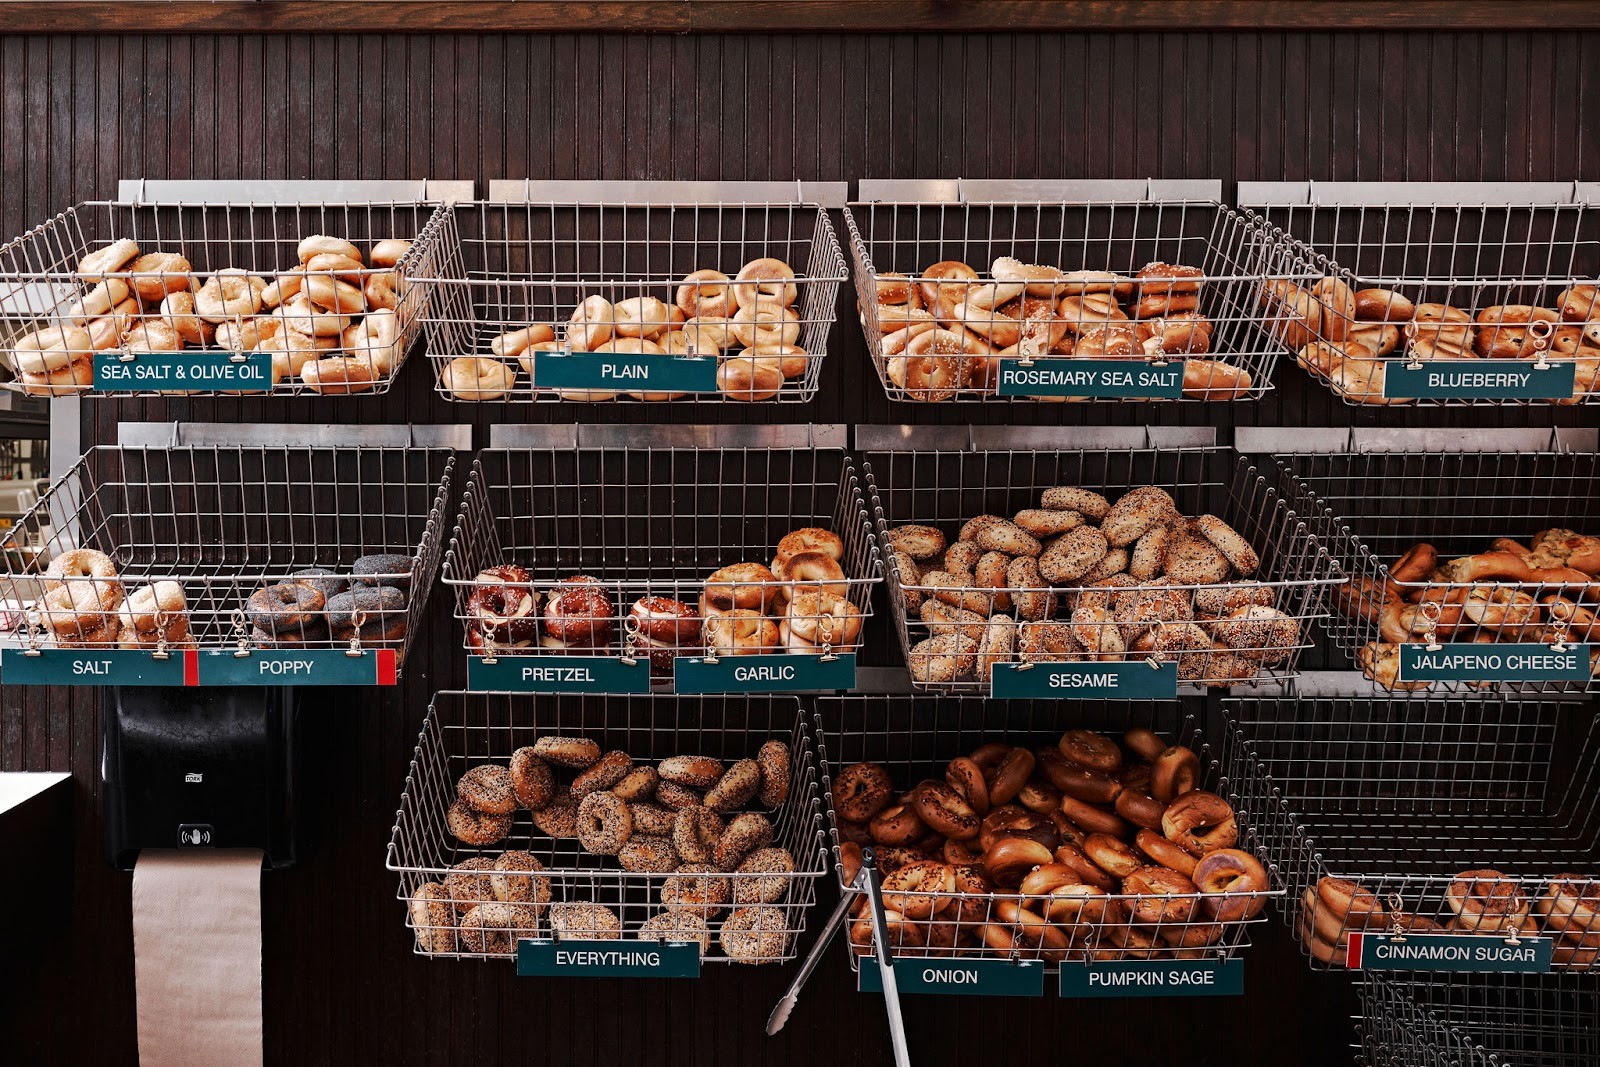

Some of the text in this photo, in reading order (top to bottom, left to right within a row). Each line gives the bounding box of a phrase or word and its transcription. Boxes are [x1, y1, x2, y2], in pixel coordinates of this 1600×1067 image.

[102, 365, 264, 379] SEA SALT & OLIVE OIL
[601, 364, 649, 379] PLAIN
[1004, 370, 1179, 387] ROSEMARY SEA SALT
[1428, 373, 1530, 388] BLUEBERRY
[73, 660, 112, 675] SALT
[259, 660, 314, 675] POPPY
[1412, 655, 1577, 670] JALAPENO CHEESE
[522, 667, 595, 682] PRETZEL
[734, 666, 796, 682] GARLIC
[1049, 673, 1119, 689] SESAME
[556, 951, 661, 967] EVERYTHING
[1376, 944, 1537, 962] CINNAMON SUGAR
[922, 969, 979, 984] ONION
[1089, 970, 1215, 986] PUMPKIN SAGE
